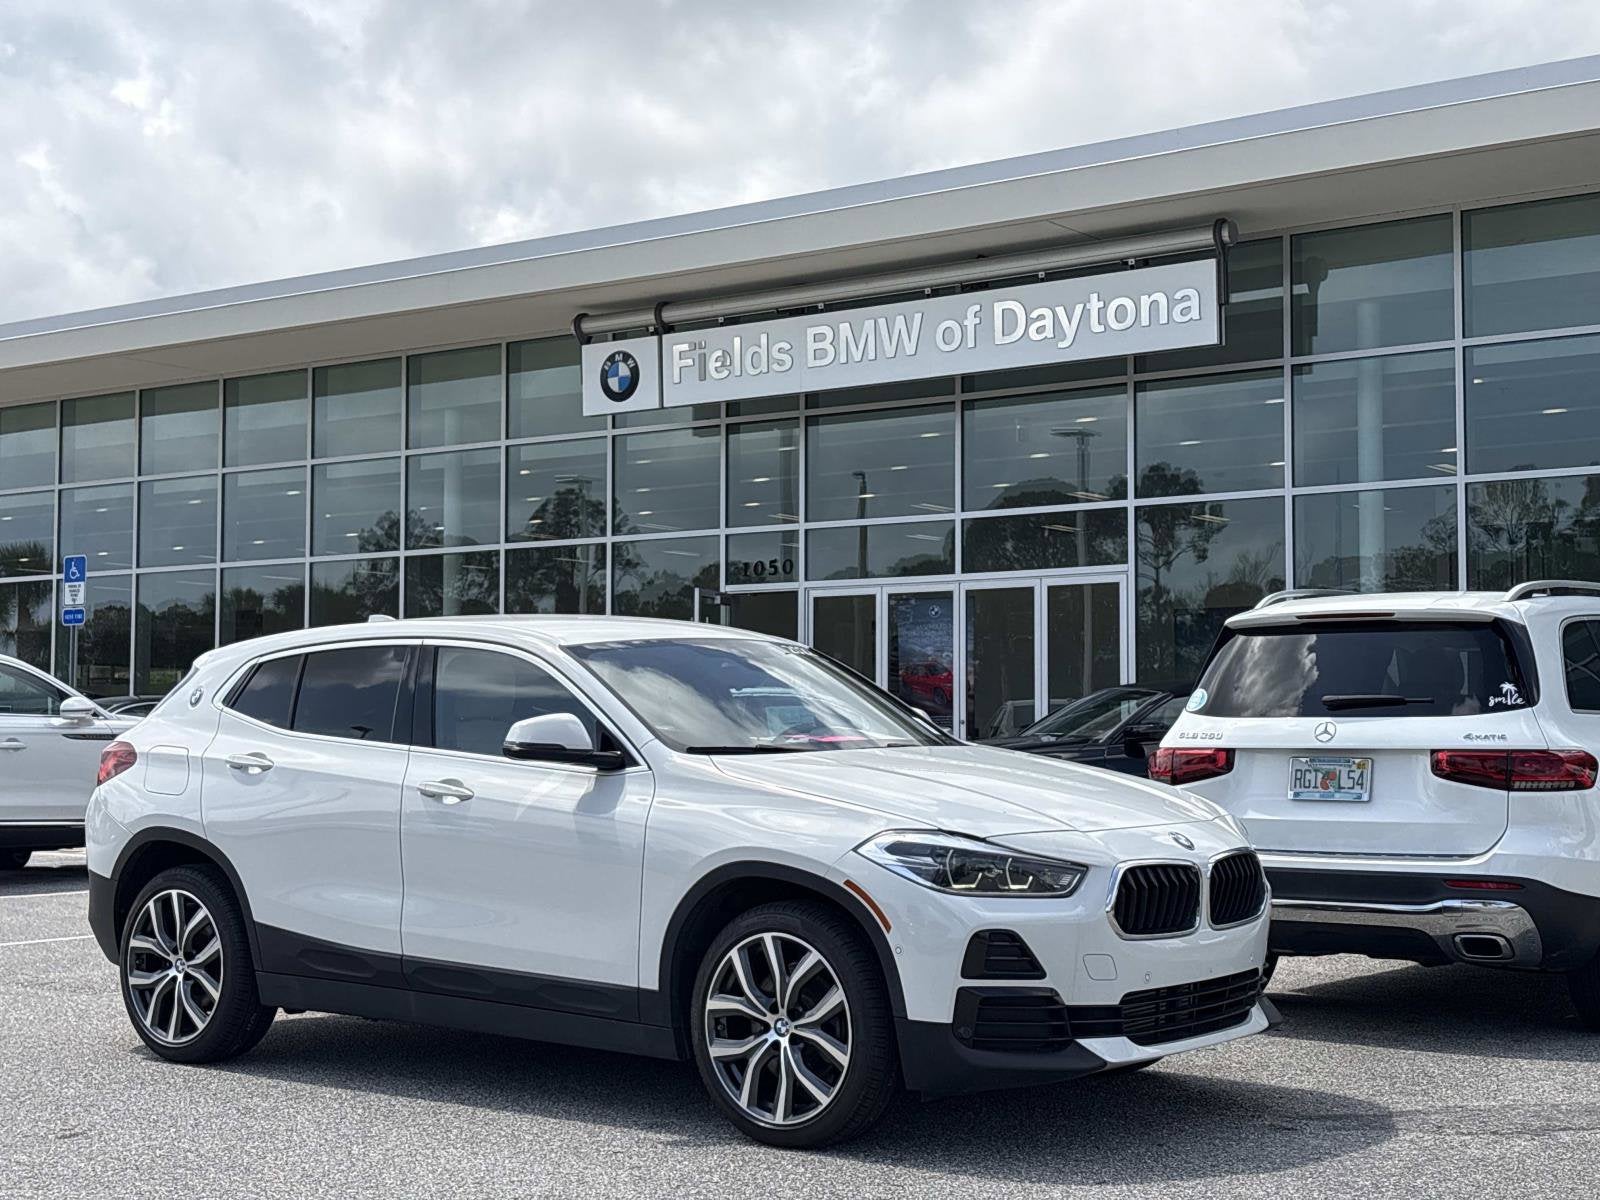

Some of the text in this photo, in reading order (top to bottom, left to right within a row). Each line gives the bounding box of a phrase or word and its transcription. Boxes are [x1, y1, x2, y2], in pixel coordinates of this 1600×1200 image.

[673, 287, 1202, 384] Fields BMW of Daytona
[742, 558, 794, 577] 1050
